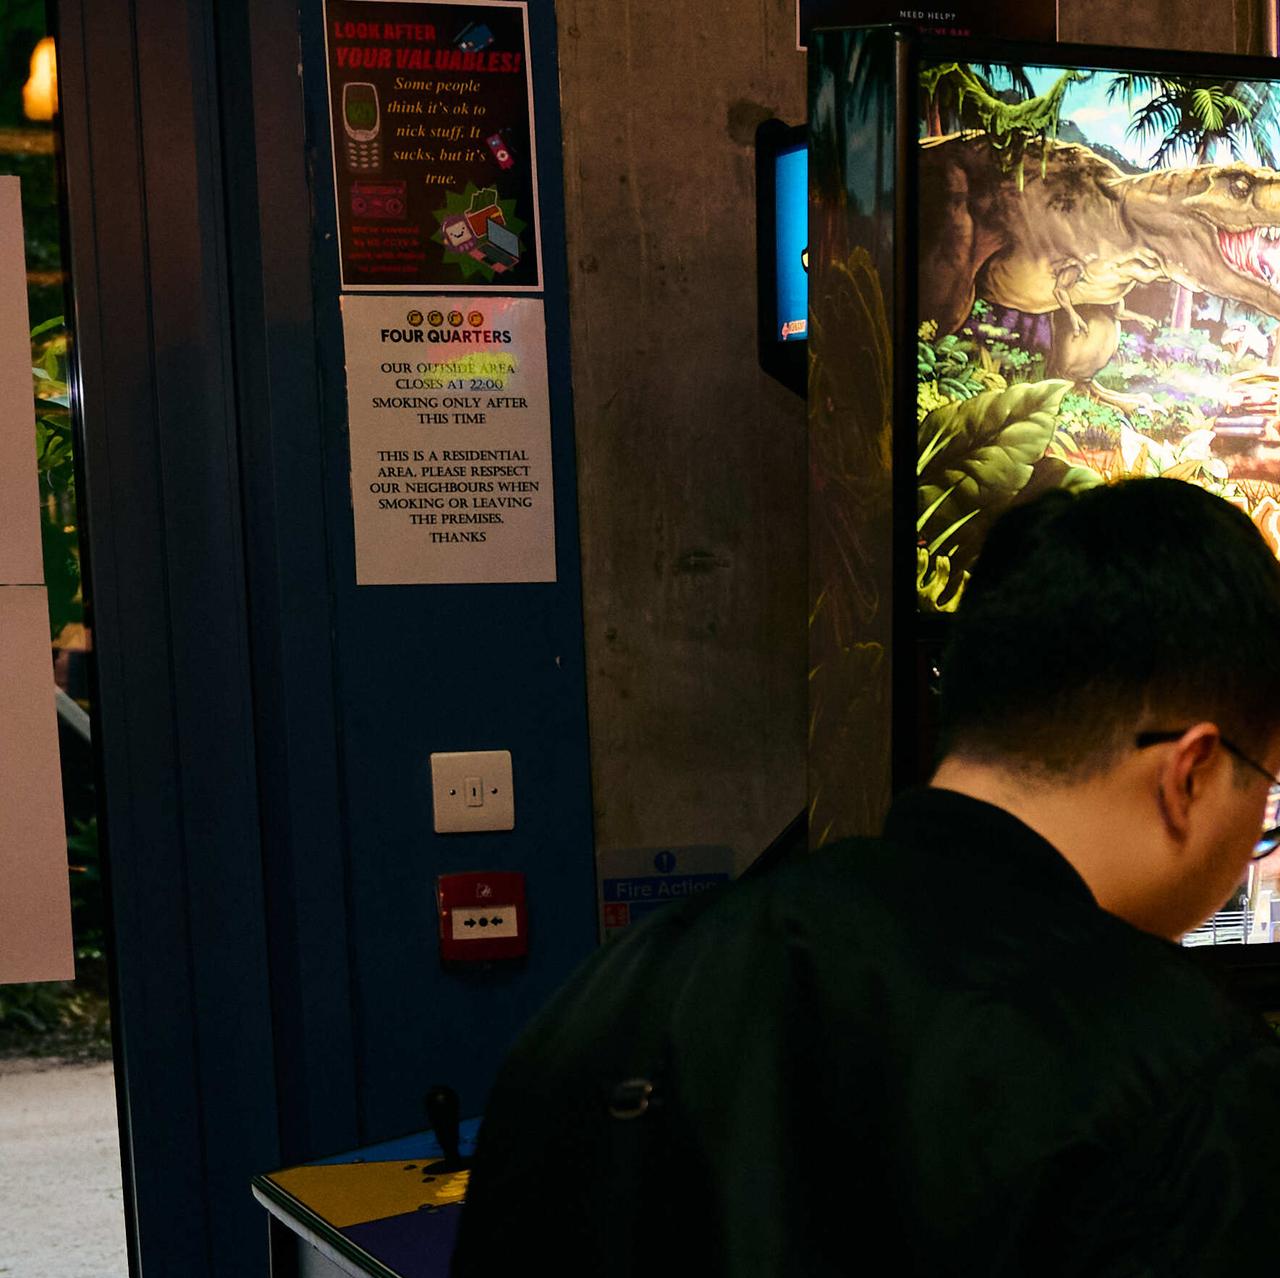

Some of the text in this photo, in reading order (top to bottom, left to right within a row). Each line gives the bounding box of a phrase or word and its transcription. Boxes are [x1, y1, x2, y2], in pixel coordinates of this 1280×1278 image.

[900, 10, 924, 19] NEED
[334, 22, 436, 40] LOOK AFTER
[336, 47, 521, 73] YOUR VALUABLES!
[394, 77, 480, 98] Some people
[387, 101, 486, 116] think it's ok to
[396, 125, 480, 141] nick stuff. It
[393, 149, 487, 162] sucks, but it's
[425, 172, 456, 184] true.
[381, 329, 512, 344] FOUR QUARTERS
[381, 363, 515, 374] OUR OUTSIDE AREA
[395, 379, 444, 389] CLOSES
[448, 379, 464, 389] AT
[372, 397, 528, 408] SMOKING ONLY AFTER
[417, 413, 486, 424] THIS TIME
[377, 450, 529, 461] THIS IS A RESIDENTIAL
[378, 466, 530, 477] AREA. PLEASE RESPSECT
[370, 481, 539, 493] OUR NEIGHBOURS WHEN
[378, 497, 532, 509] SMOKING OR LEAVING
[409, 513, 504, 525] THE PREMISES.
[429, 532, 487, 543] THANKS
[616, 882, 653, 898] Fire
